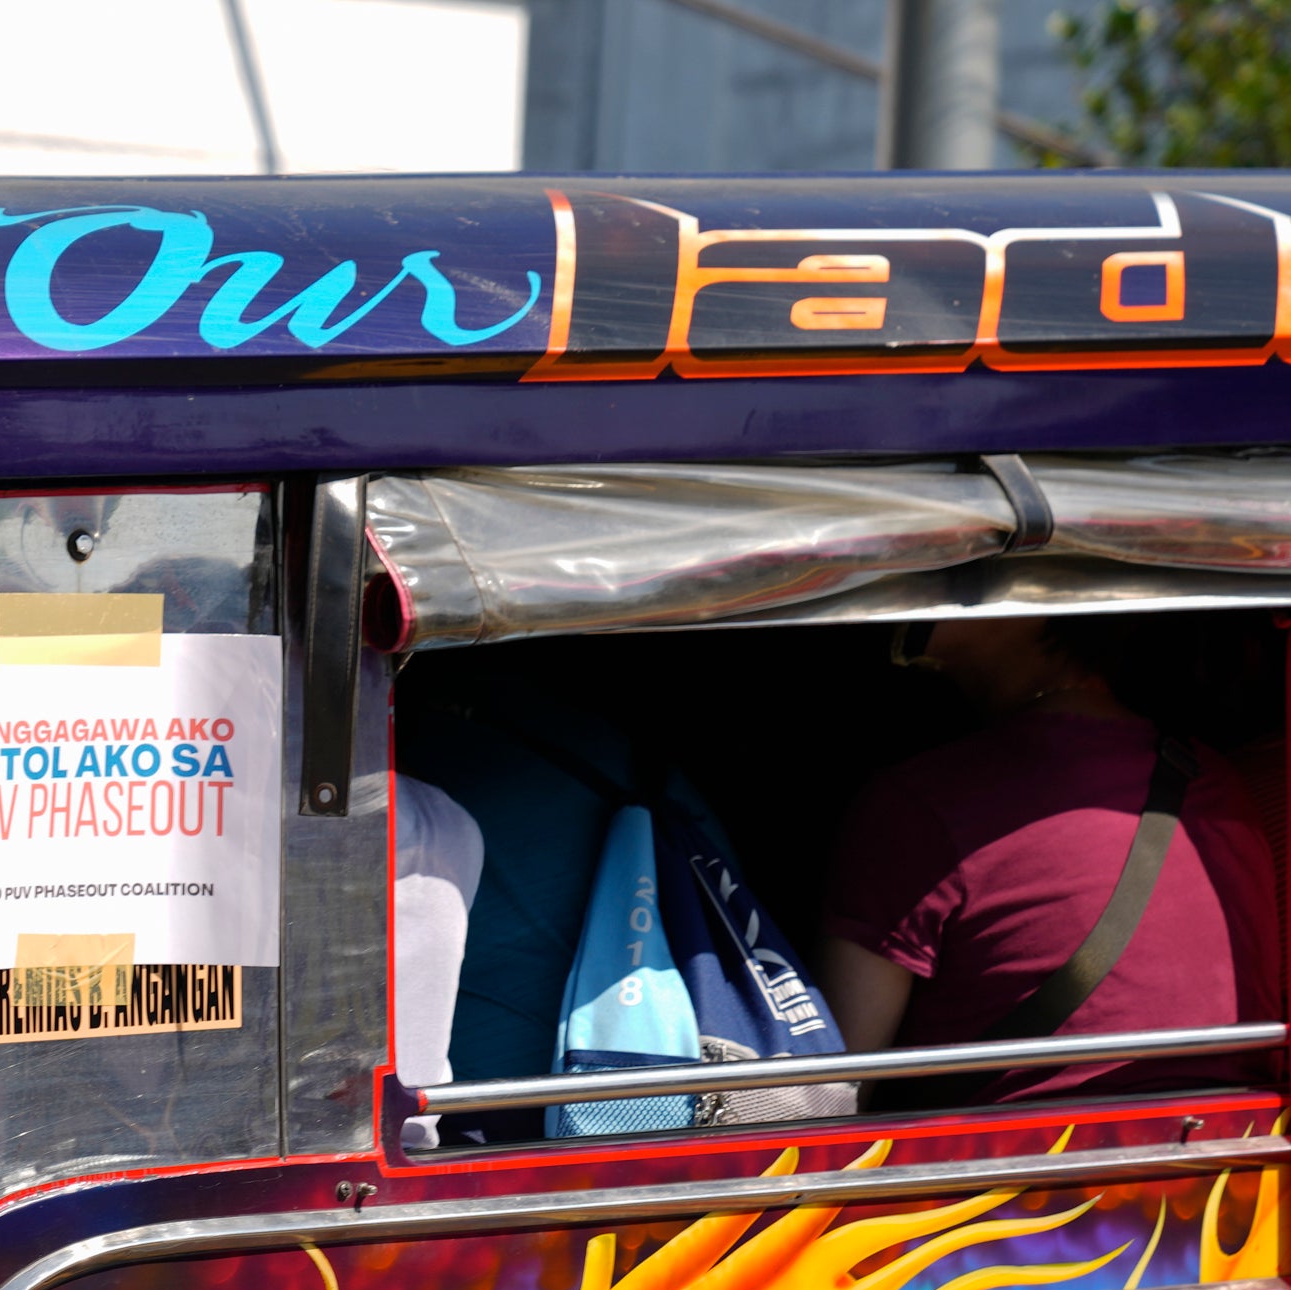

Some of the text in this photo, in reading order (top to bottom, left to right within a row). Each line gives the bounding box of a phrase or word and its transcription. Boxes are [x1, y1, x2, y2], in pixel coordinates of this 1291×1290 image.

[165, 718, 235, 742] AKO
[74, 743, 161, 778] AKO
[171, 744, 234, 778] SA
[27, 780, 234, 839] PHASEOUT
[5, 886, 32, 900] PUV
[34, 883, 117, 898] PHASEOUT
[120, 883, 214, 897] COALITION
[115, 964, 235, 1028] ANGANGAN
